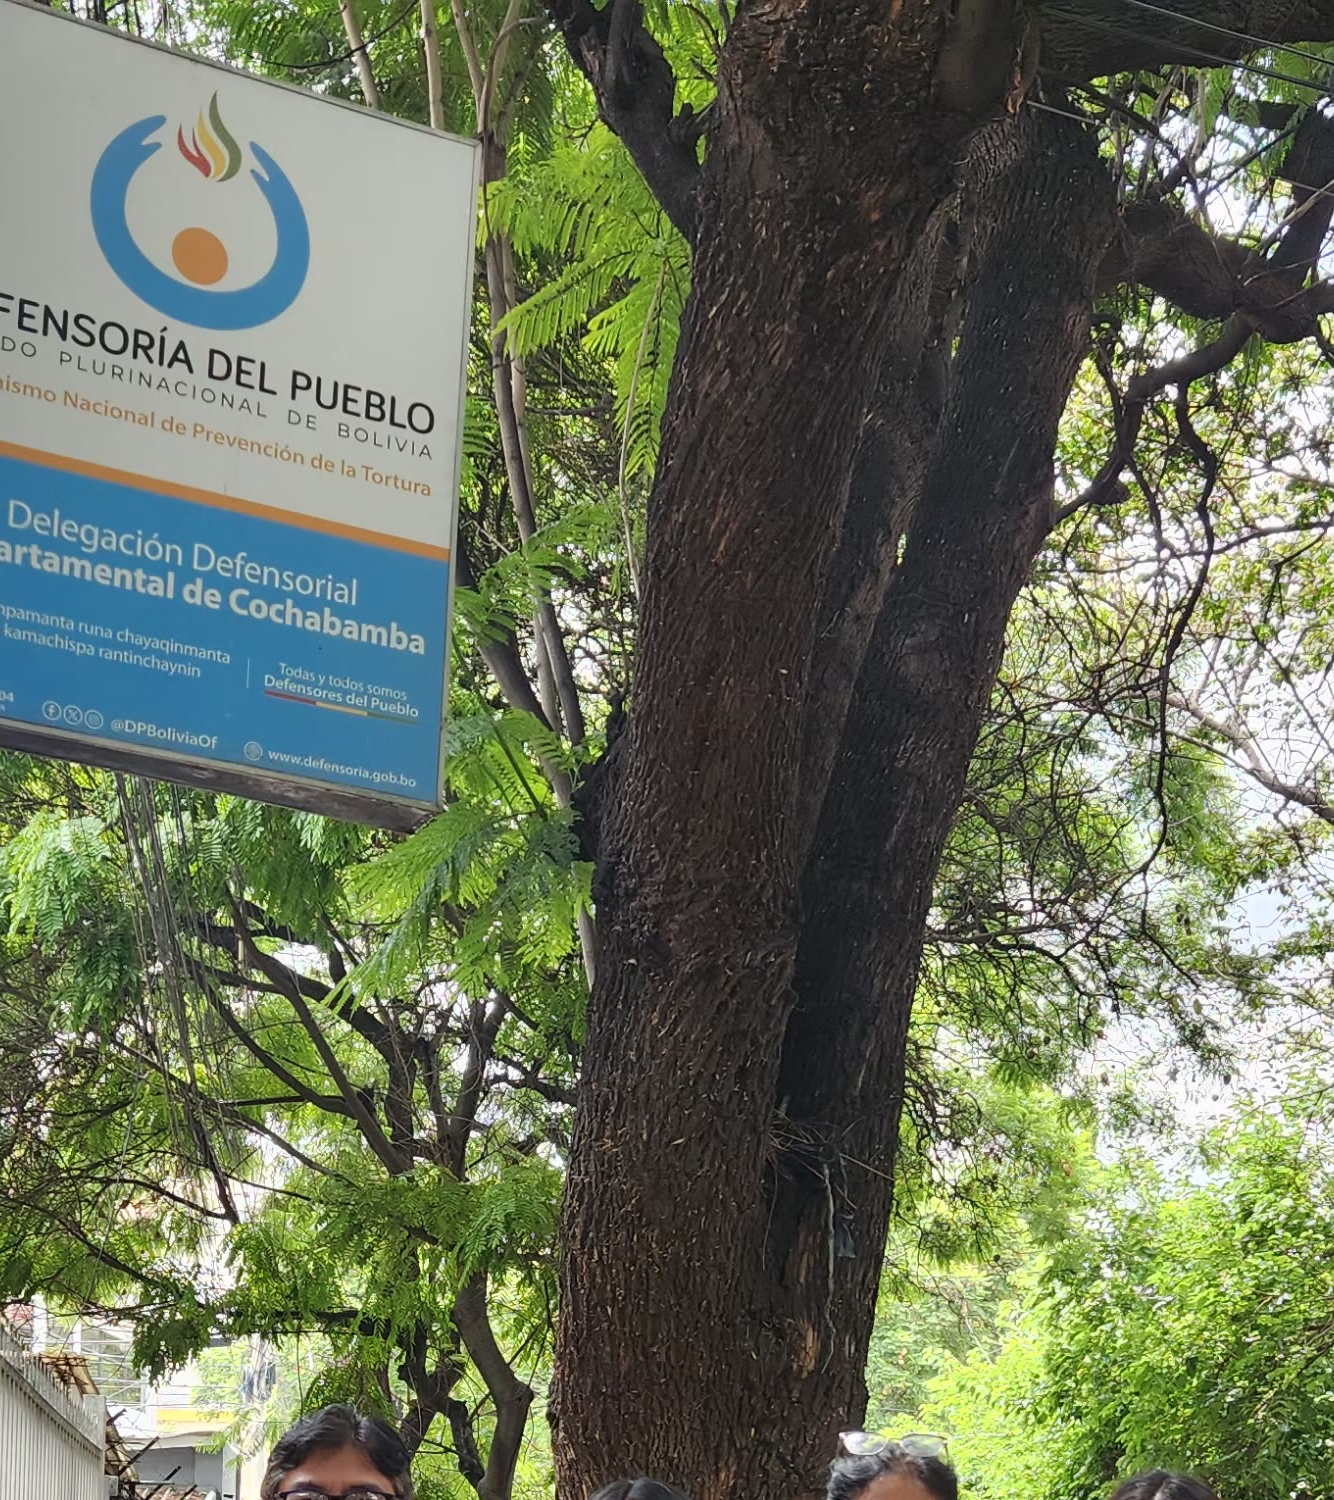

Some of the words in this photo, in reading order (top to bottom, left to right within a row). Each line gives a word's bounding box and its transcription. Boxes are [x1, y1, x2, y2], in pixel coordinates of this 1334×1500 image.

[59, 350, 267, 418] PLURINACIONAL
[287, 409, 317, 431] DE
[337, 422, 433, 460] BOLIVIA
[207, 347, 277, 396] DEL
[290, 369, 435, 434] PUEBLO
[63, 390, 155, 428] Nacional
[161, 416, 187, 436] de
[192, 422, 305, 465] Prevención
[310, 453, 335, 473] de
[340, 458, 357, 478] la
[362, 464, 432, 497] Tortura
[7, 499, 183, 566] Delegación
[192, 542, 358, 606] Defensorial
[78, 621, 113, 640] runa
[116, 627, 231, 665] chayaqinmanta
[182, 577, 222, 610] de
[229, 587, 426, 656] Cochabamba
[3, 623, 95, 657] kamachispa
[98, 647, 202, 678] rantinchaynin
[264, 673, 343, 703] Defensores
[346, 692, 367, 708] del
[370, 697, 419, 718] Pueblo
[278, 661, 316, 683] Todas
[317, 673, 327, 686] y
[328, 675, 365, 693] todos
[367, 684, 408, 701] somos
[110, 719, 219, 750] @DPBoliviaOf
[268, 749, 417, 788] www.defensoria.gob.bo
